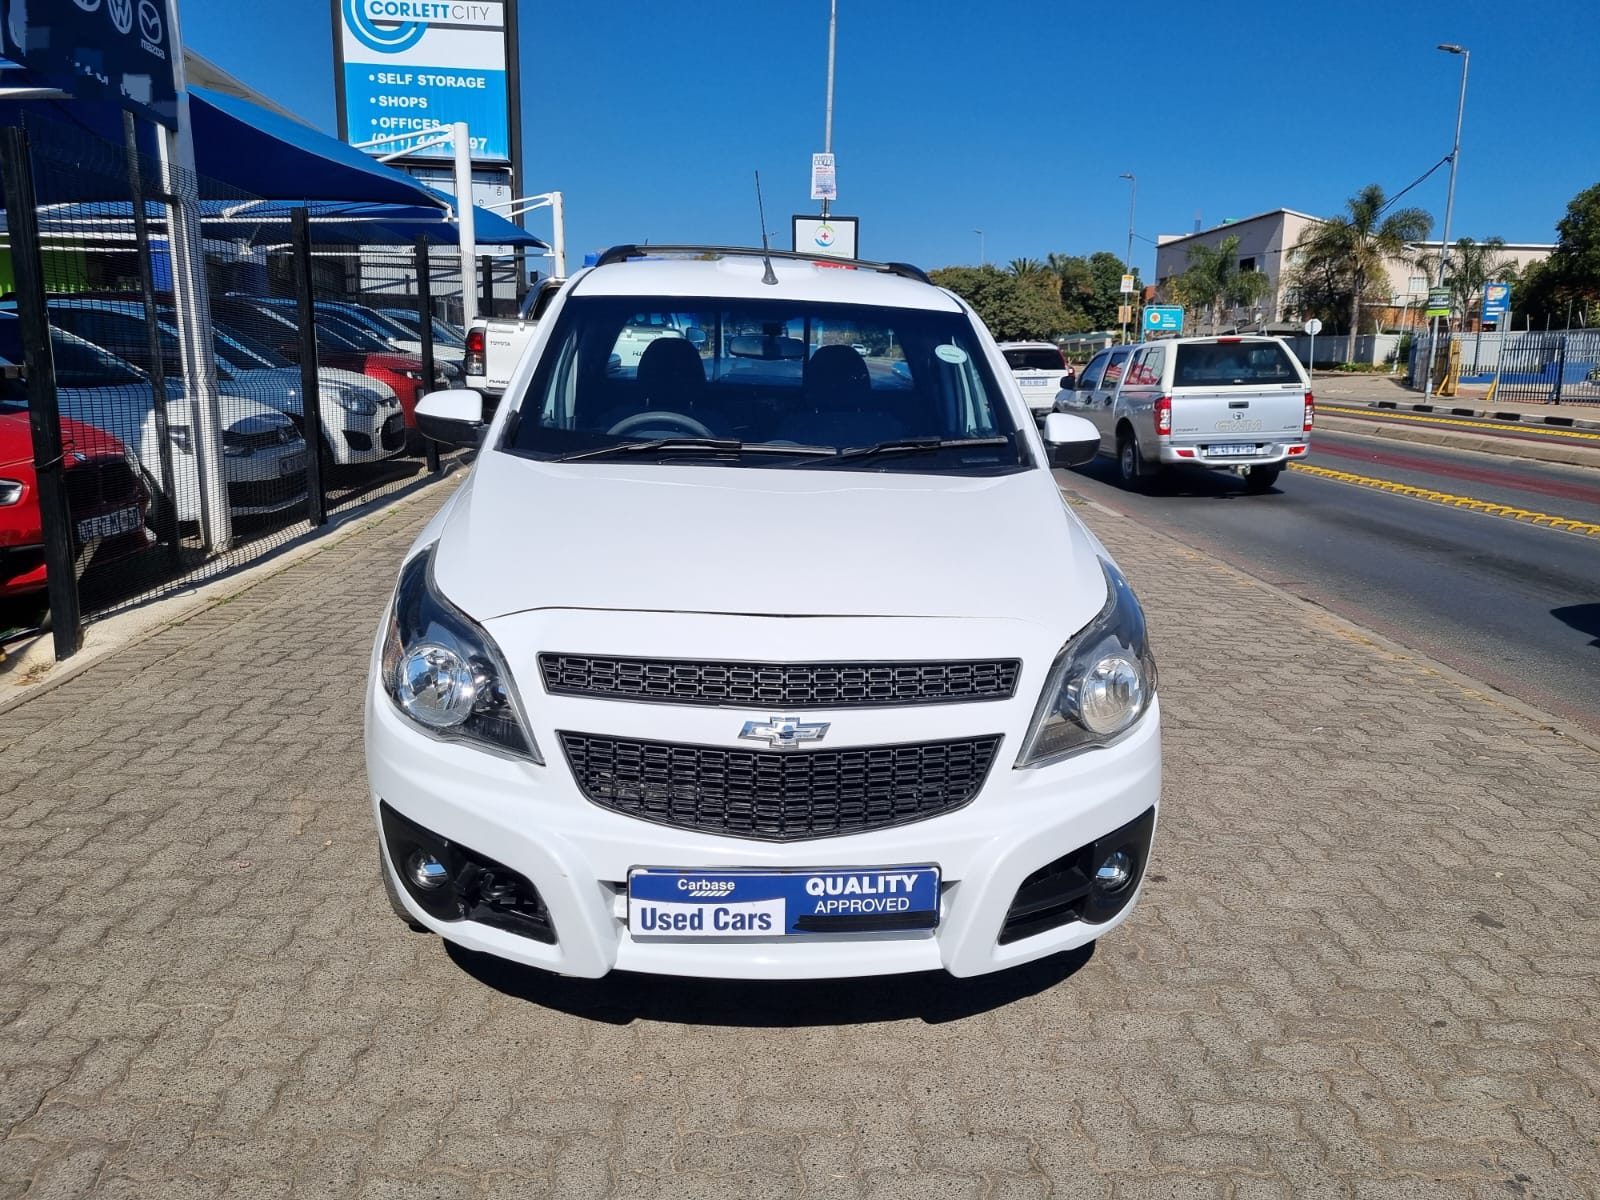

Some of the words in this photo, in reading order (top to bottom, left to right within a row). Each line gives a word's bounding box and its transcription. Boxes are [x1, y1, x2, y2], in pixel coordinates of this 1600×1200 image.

[140, 38, 166, 60] mazda
[377, 72, 413, 85] SELF
[417, 74, 486, 89] STORAGE
[378, 95, 428, 109] SHOPS
[379, 116, 441, 130] OFFICES
[677, 879, 736, 891] Carbase
[805, 873, 919, 897] QUALITY
[814, 897, 910, 914] APPROVED
[641, 906, 704, 931] Used
[713, 907, 772, 932] Cars
